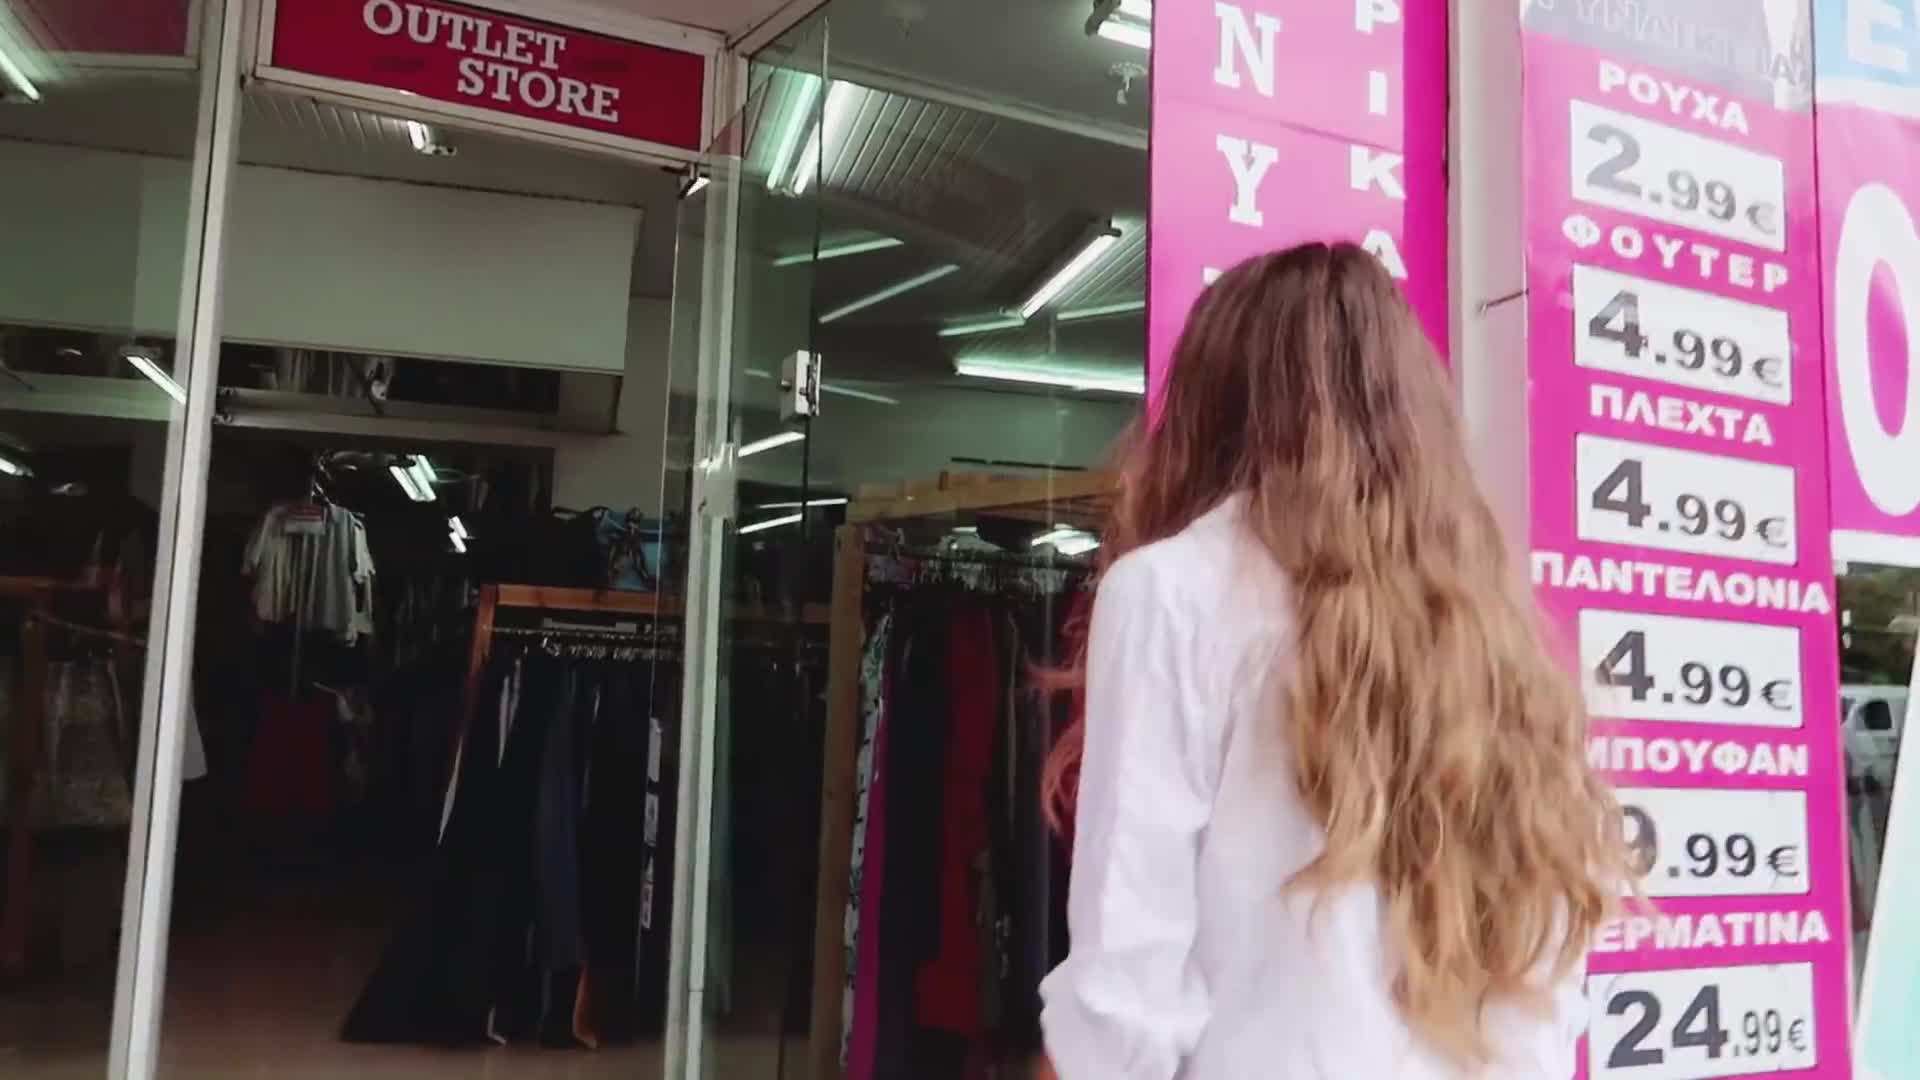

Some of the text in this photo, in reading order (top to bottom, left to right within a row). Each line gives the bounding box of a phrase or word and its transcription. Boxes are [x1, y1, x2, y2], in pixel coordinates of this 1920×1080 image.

[363, 0, 566, 69] OUTLET
[457, 59, 620, 123] STORE
[1599, 59, 1749, 135] ΡΟΥΧΑ
[1562, 213, 1789, 293] ΦΟΥΤΕΡ
[1589, 290, 1783, 388] 4.99€
[1589, 384, 1773, 447] ΠΛΕΧΤΑ
[1591, 459, 1788, 548] 4.99€
[1530, 551, 1831, 616] ΠΑΝΤΕΛΟΝΙΑ
[1595, 631, 1793, 711] 4.99€
[1606, 983, 1808, 1070] 24.99€
